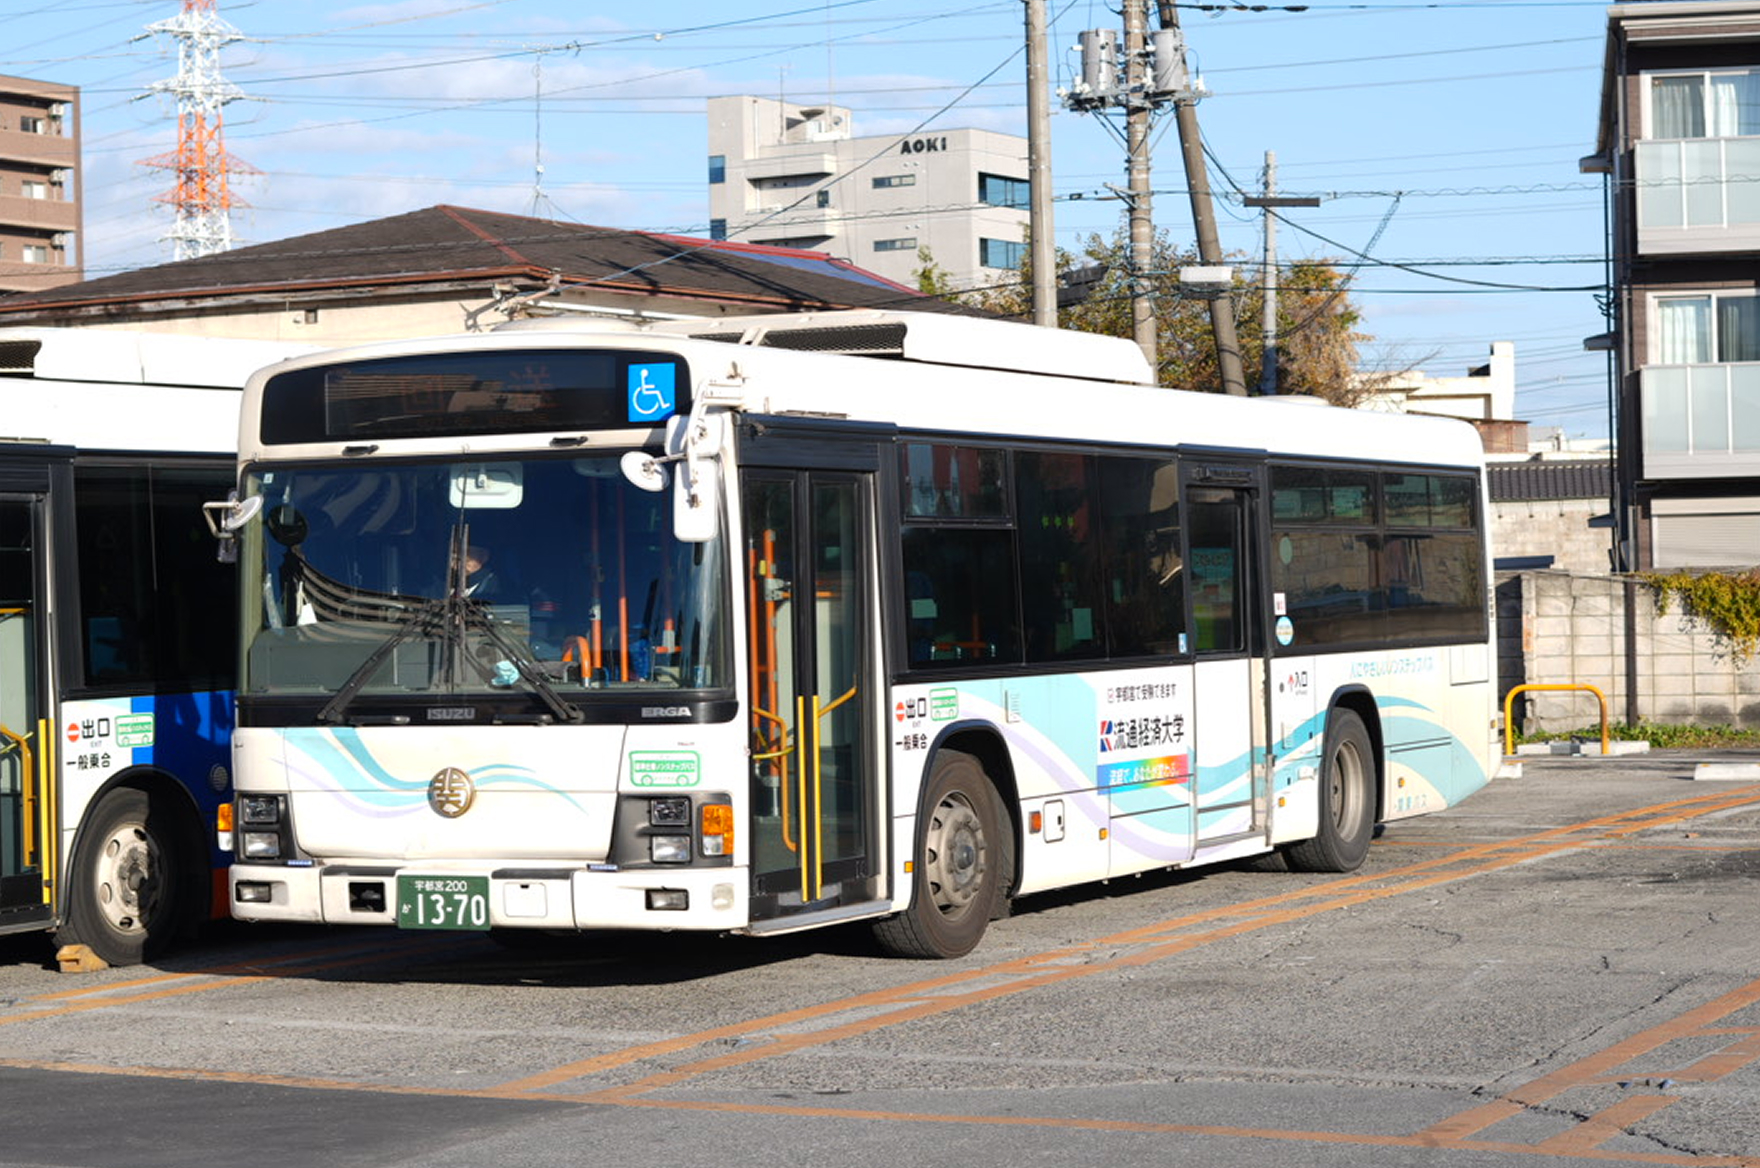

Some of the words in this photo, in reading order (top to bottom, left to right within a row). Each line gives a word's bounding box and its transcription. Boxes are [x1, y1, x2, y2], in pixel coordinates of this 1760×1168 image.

[900, 137, 947, 155] AOKI
[1294, 670, 1308, 688] 入口
[427, 707, 476, 720] ISUZU
[641, 706, 692, 719] ERGA
[905, 697, 927, 719] 出口
[82, 717, 110, 740] 出口
[1113, 714, 1185, 750] 流通経済大学
[895, 733, 928, 751] 一般乗合
[66, 752, 112, 770] 一般乗合
[417, 892, 486, 926] 13-70
